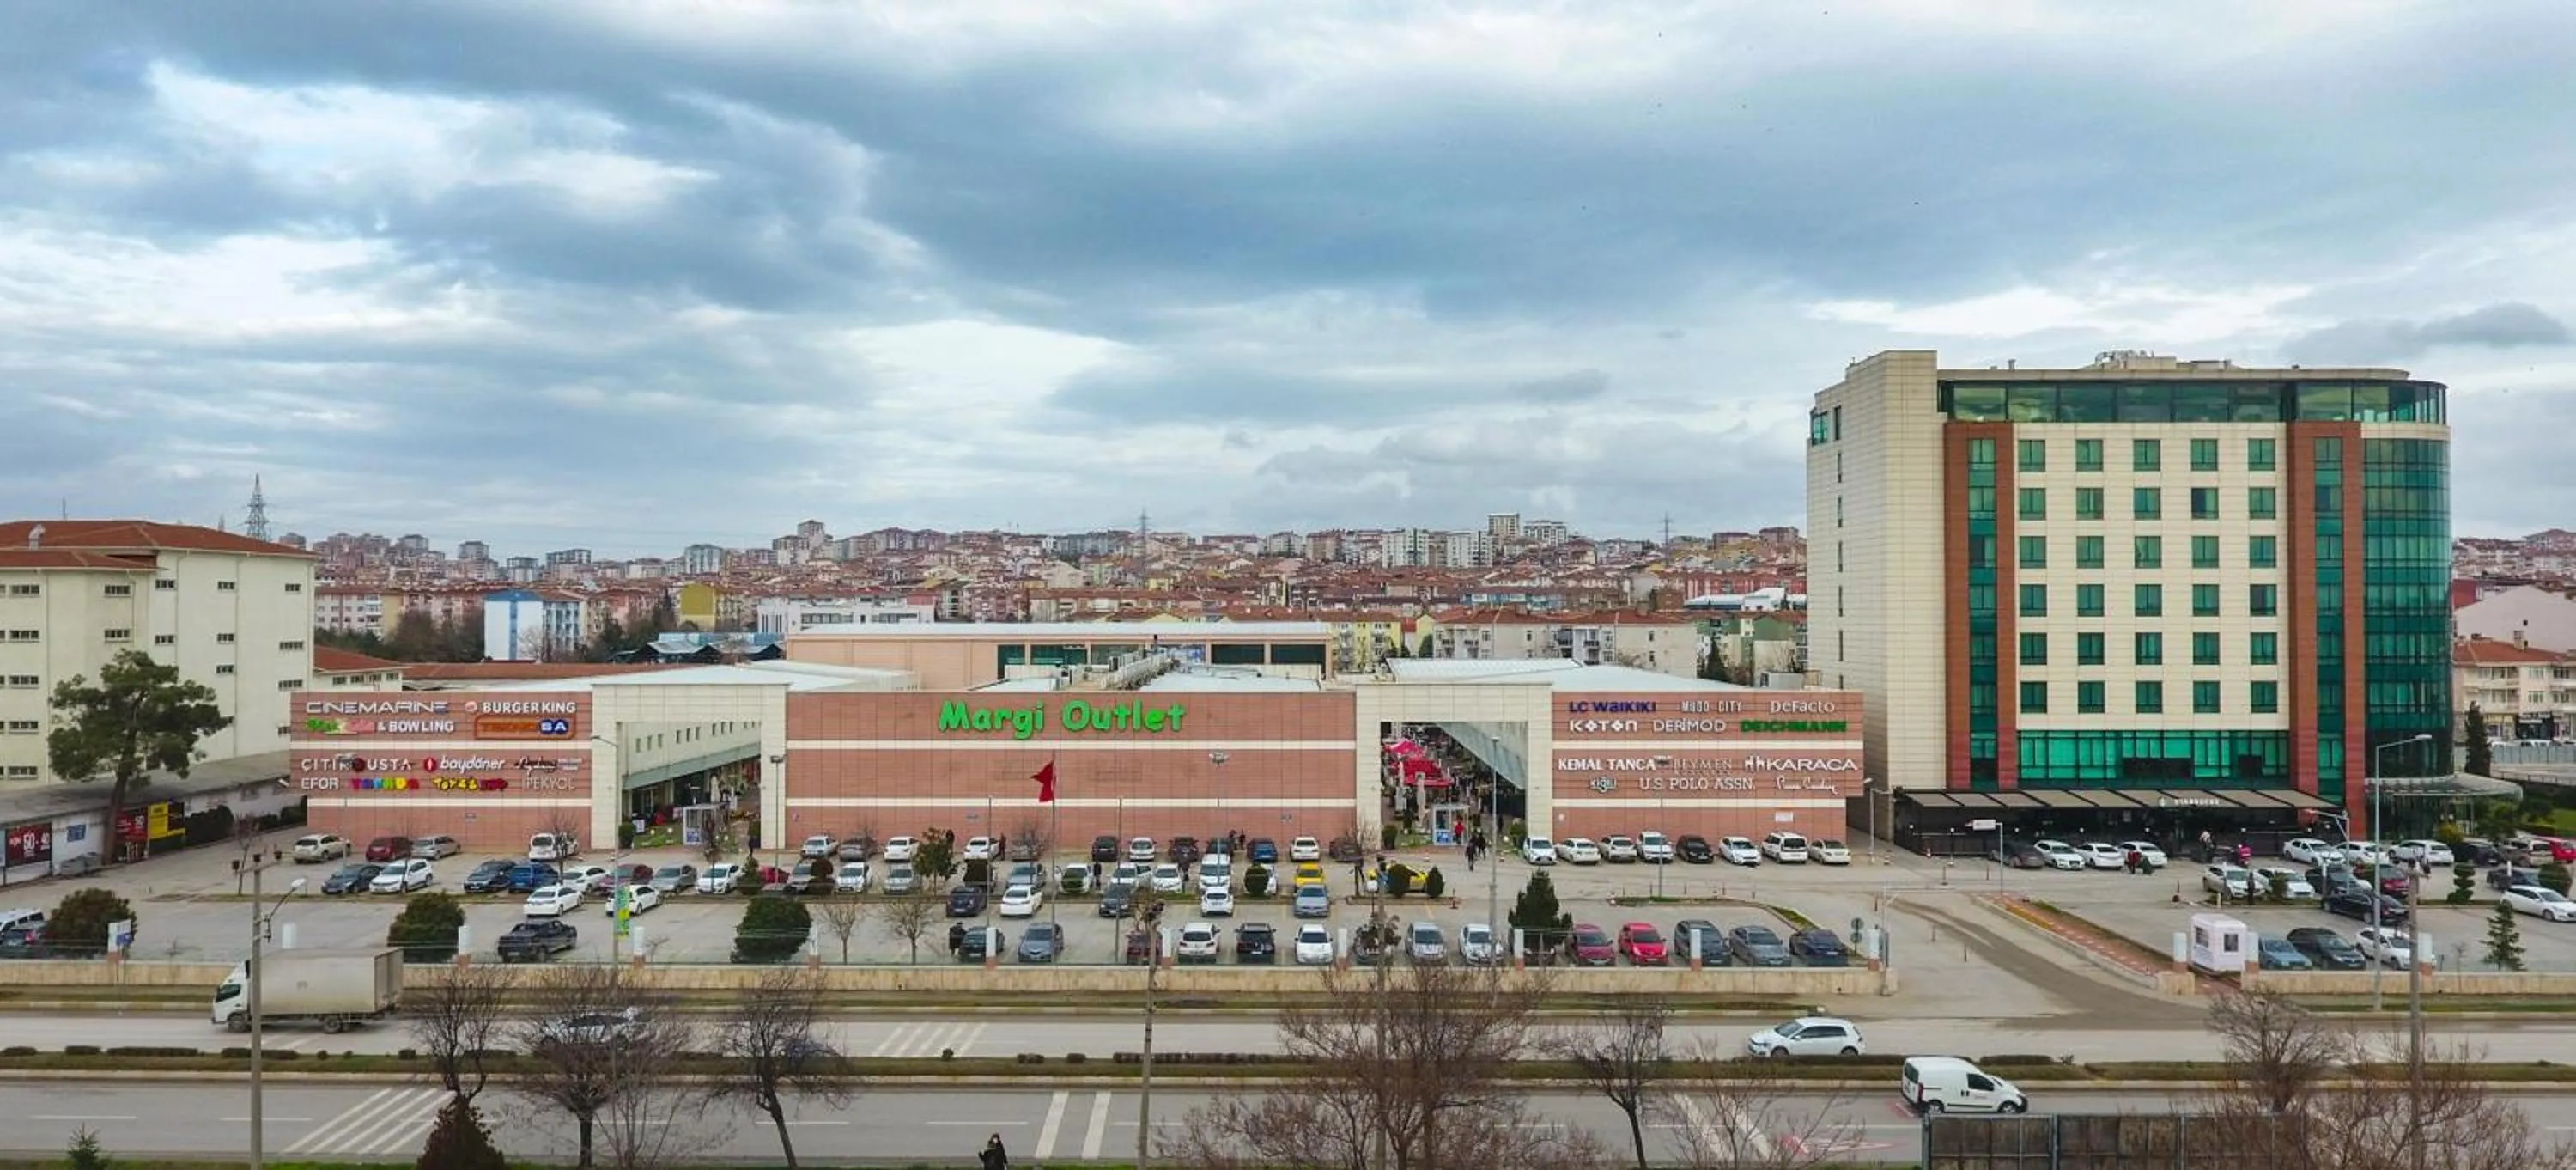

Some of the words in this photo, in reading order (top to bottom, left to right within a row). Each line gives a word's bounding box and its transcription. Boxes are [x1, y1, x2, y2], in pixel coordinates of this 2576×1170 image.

[482, 701, 540, 713] BURGER
[542, 702, 577, 713] KING
[1569, 701, 1589, 713] LC
[1718, 700, 1742, 713] CITY
[938, 700, 1045, 740] Margi
[1061, 699, 1186, 733] Outlet
[388, 720, 455, 734] BOWLING
[367, 759, 412, 771] USTA
[1558, 758, 1604, 771] KEMAL
[1606, 758, 1657, 771] TANCA
[1766, 759, 1859, 771] KARACA
[301, 777, 339, 789] EFOR
[1669, 777, 1709, 790] POLO
